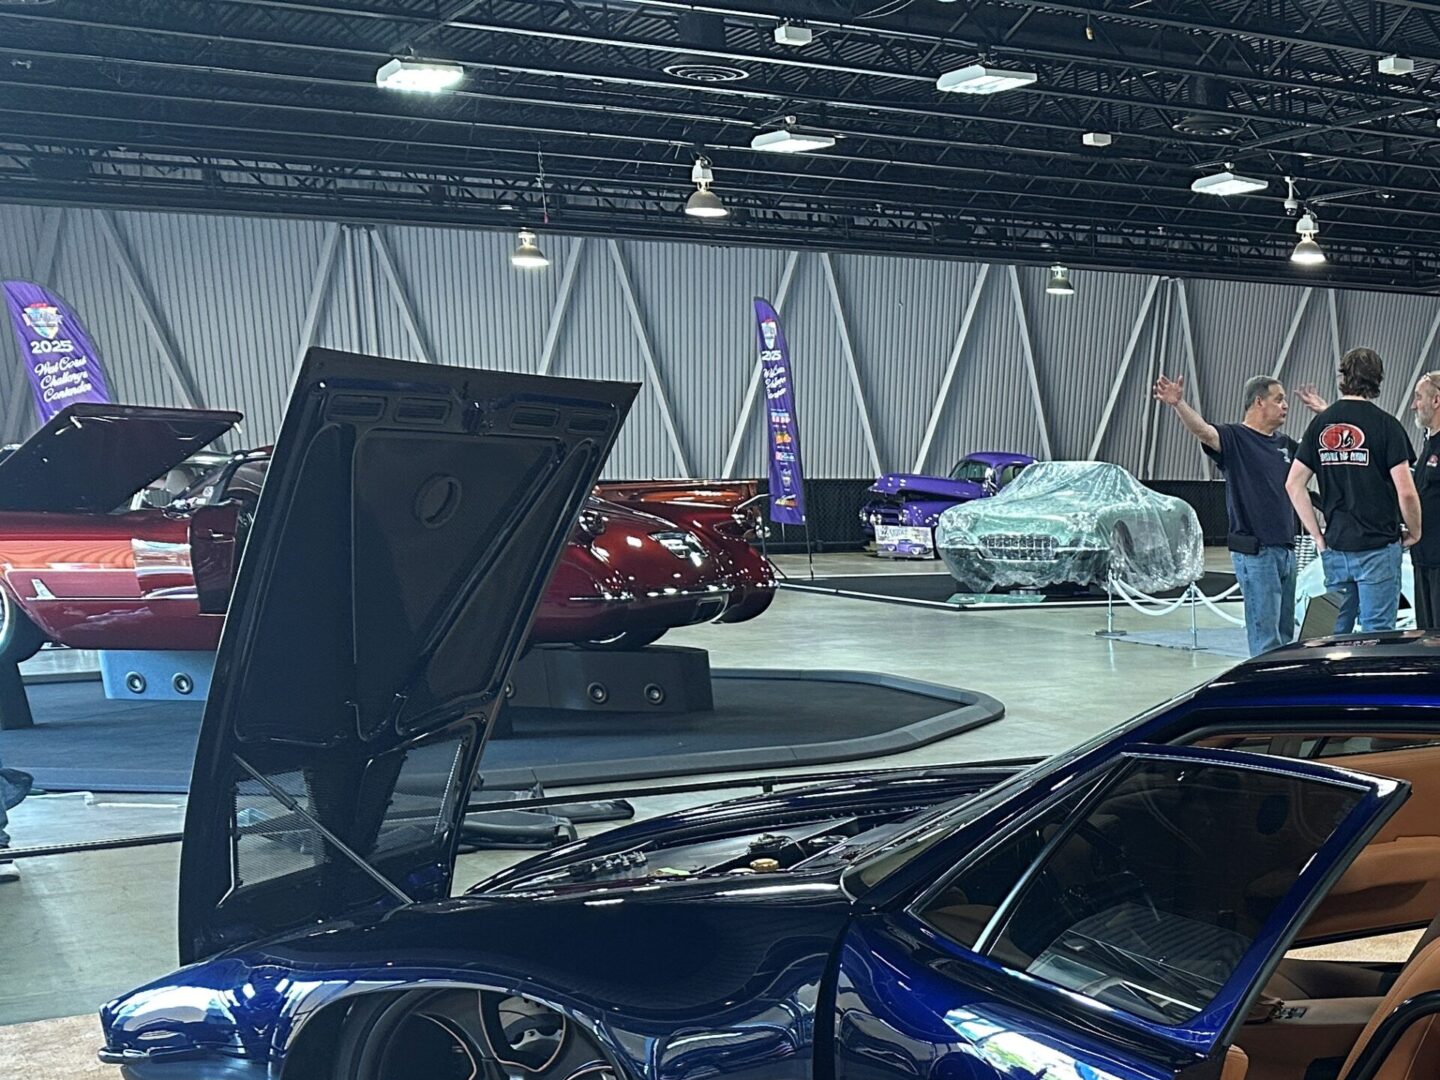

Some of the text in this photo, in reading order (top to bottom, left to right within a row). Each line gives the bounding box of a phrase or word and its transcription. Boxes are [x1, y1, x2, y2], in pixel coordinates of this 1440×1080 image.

[31, 340, 73, 353] 2025
[34, 361, 58, 376] West
[40, 371, 88, 389] Challenge
[44, 381, 91, 402] Contender
